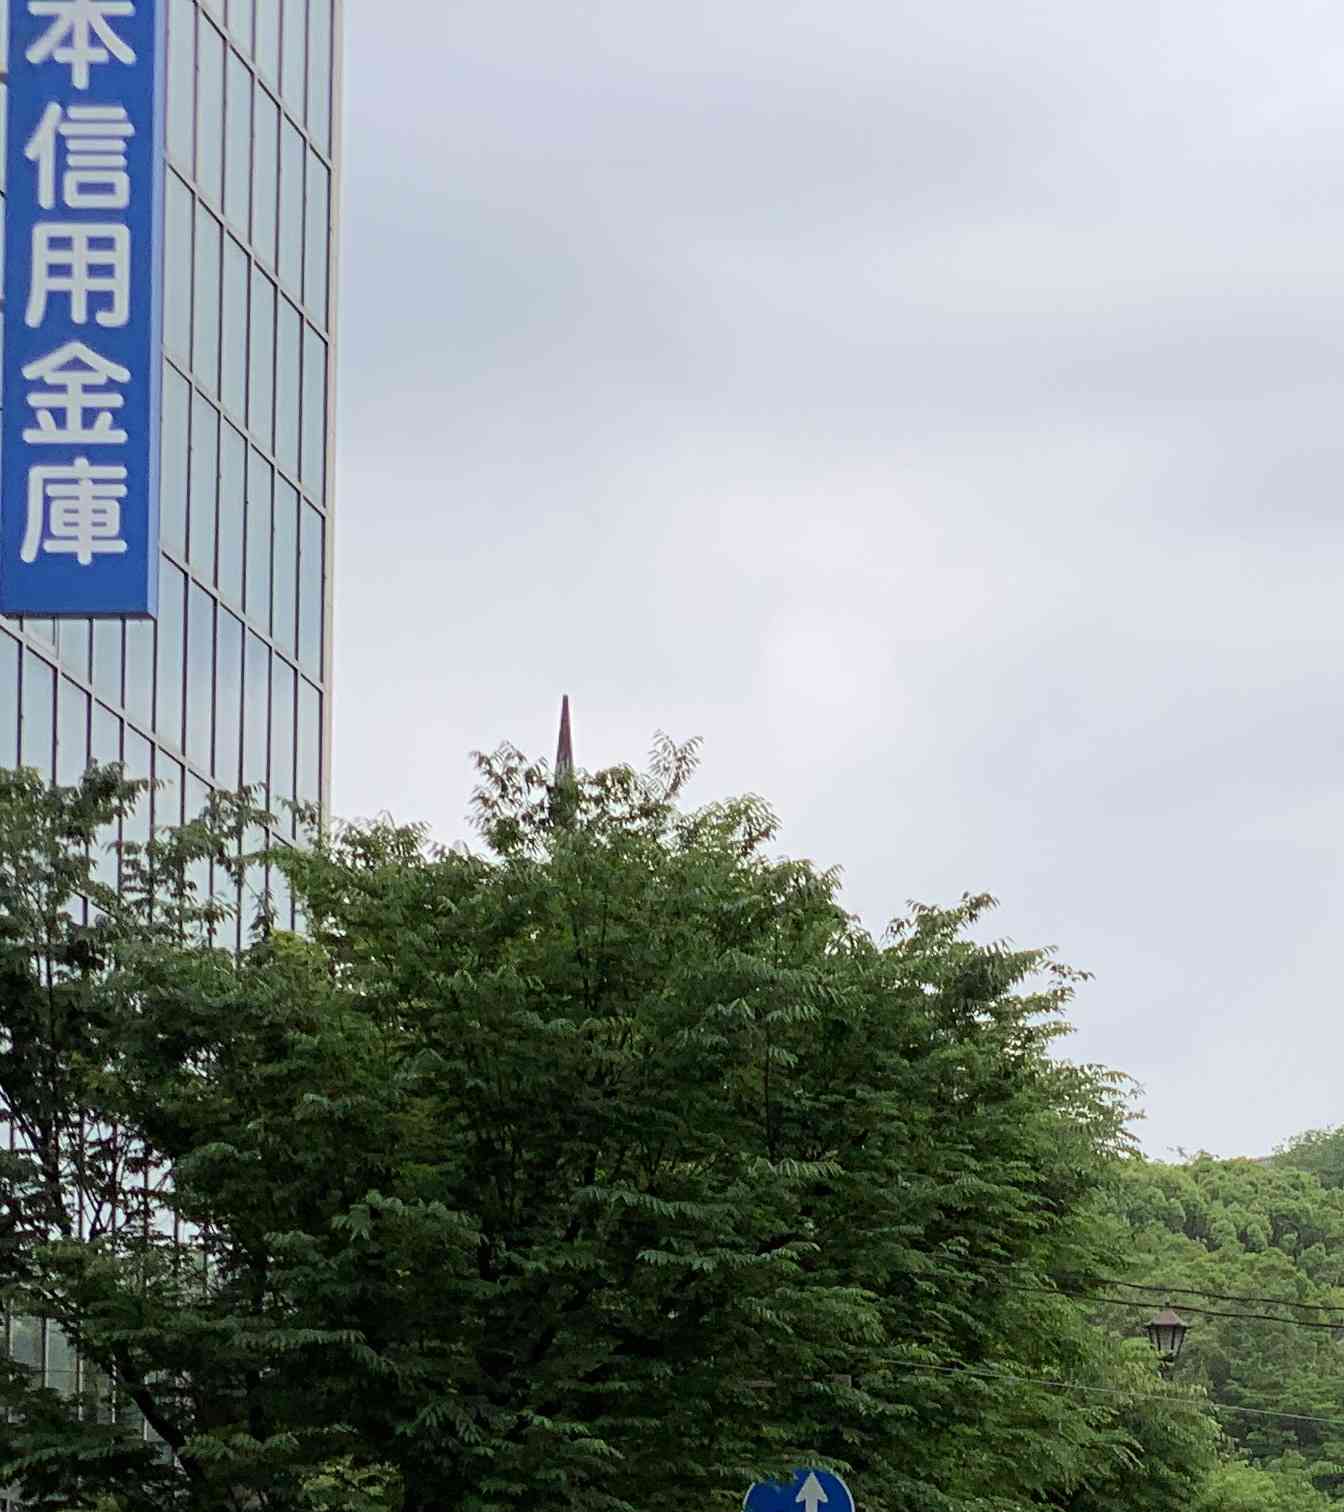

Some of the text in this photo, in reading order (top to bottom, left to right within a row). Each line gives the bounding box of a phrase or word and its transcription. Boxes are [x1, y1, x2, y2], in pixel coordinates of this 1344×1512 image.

[20, 0, 137, 565] 本信用金庫
